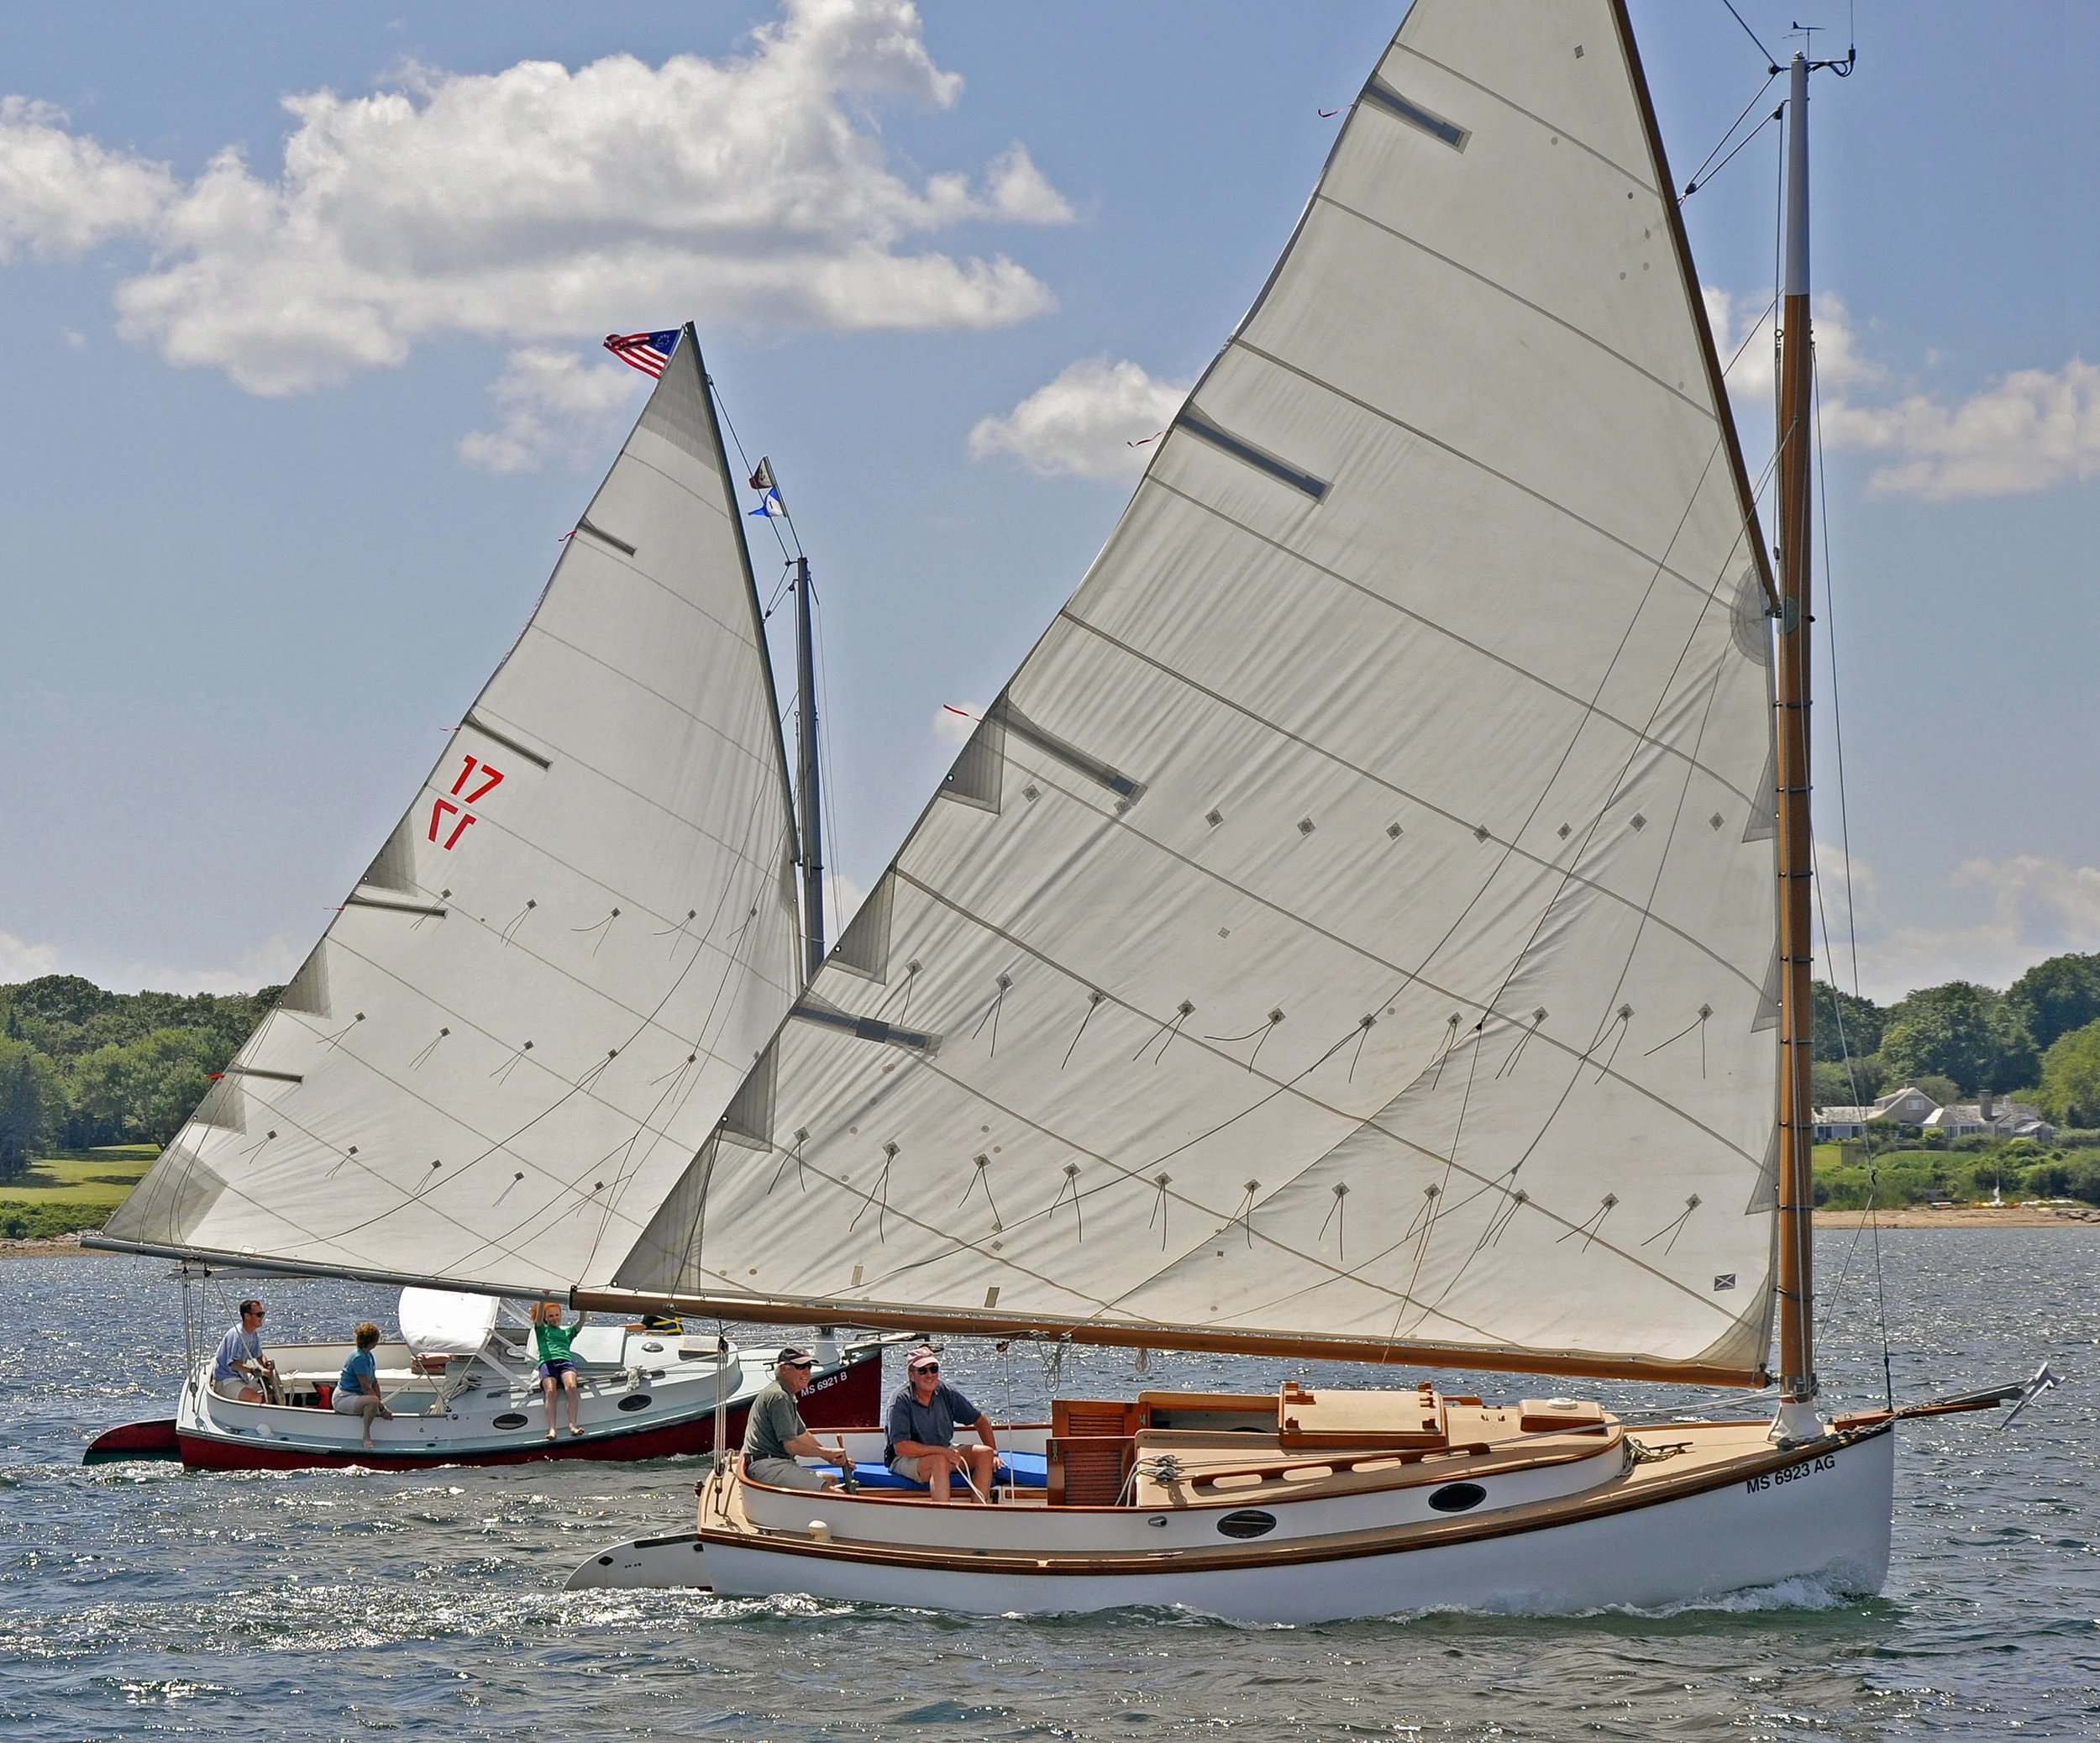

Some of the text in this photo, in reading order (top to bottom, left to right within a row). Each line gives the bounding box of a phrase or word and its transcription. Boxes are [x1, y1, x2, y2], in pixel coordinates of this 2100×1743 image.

[450, 754, 505, 804] 17
[801, 1372, 848, 1397] MS 6921 B
[1747, 1455, 1835, 1494] MS 6923 AG
